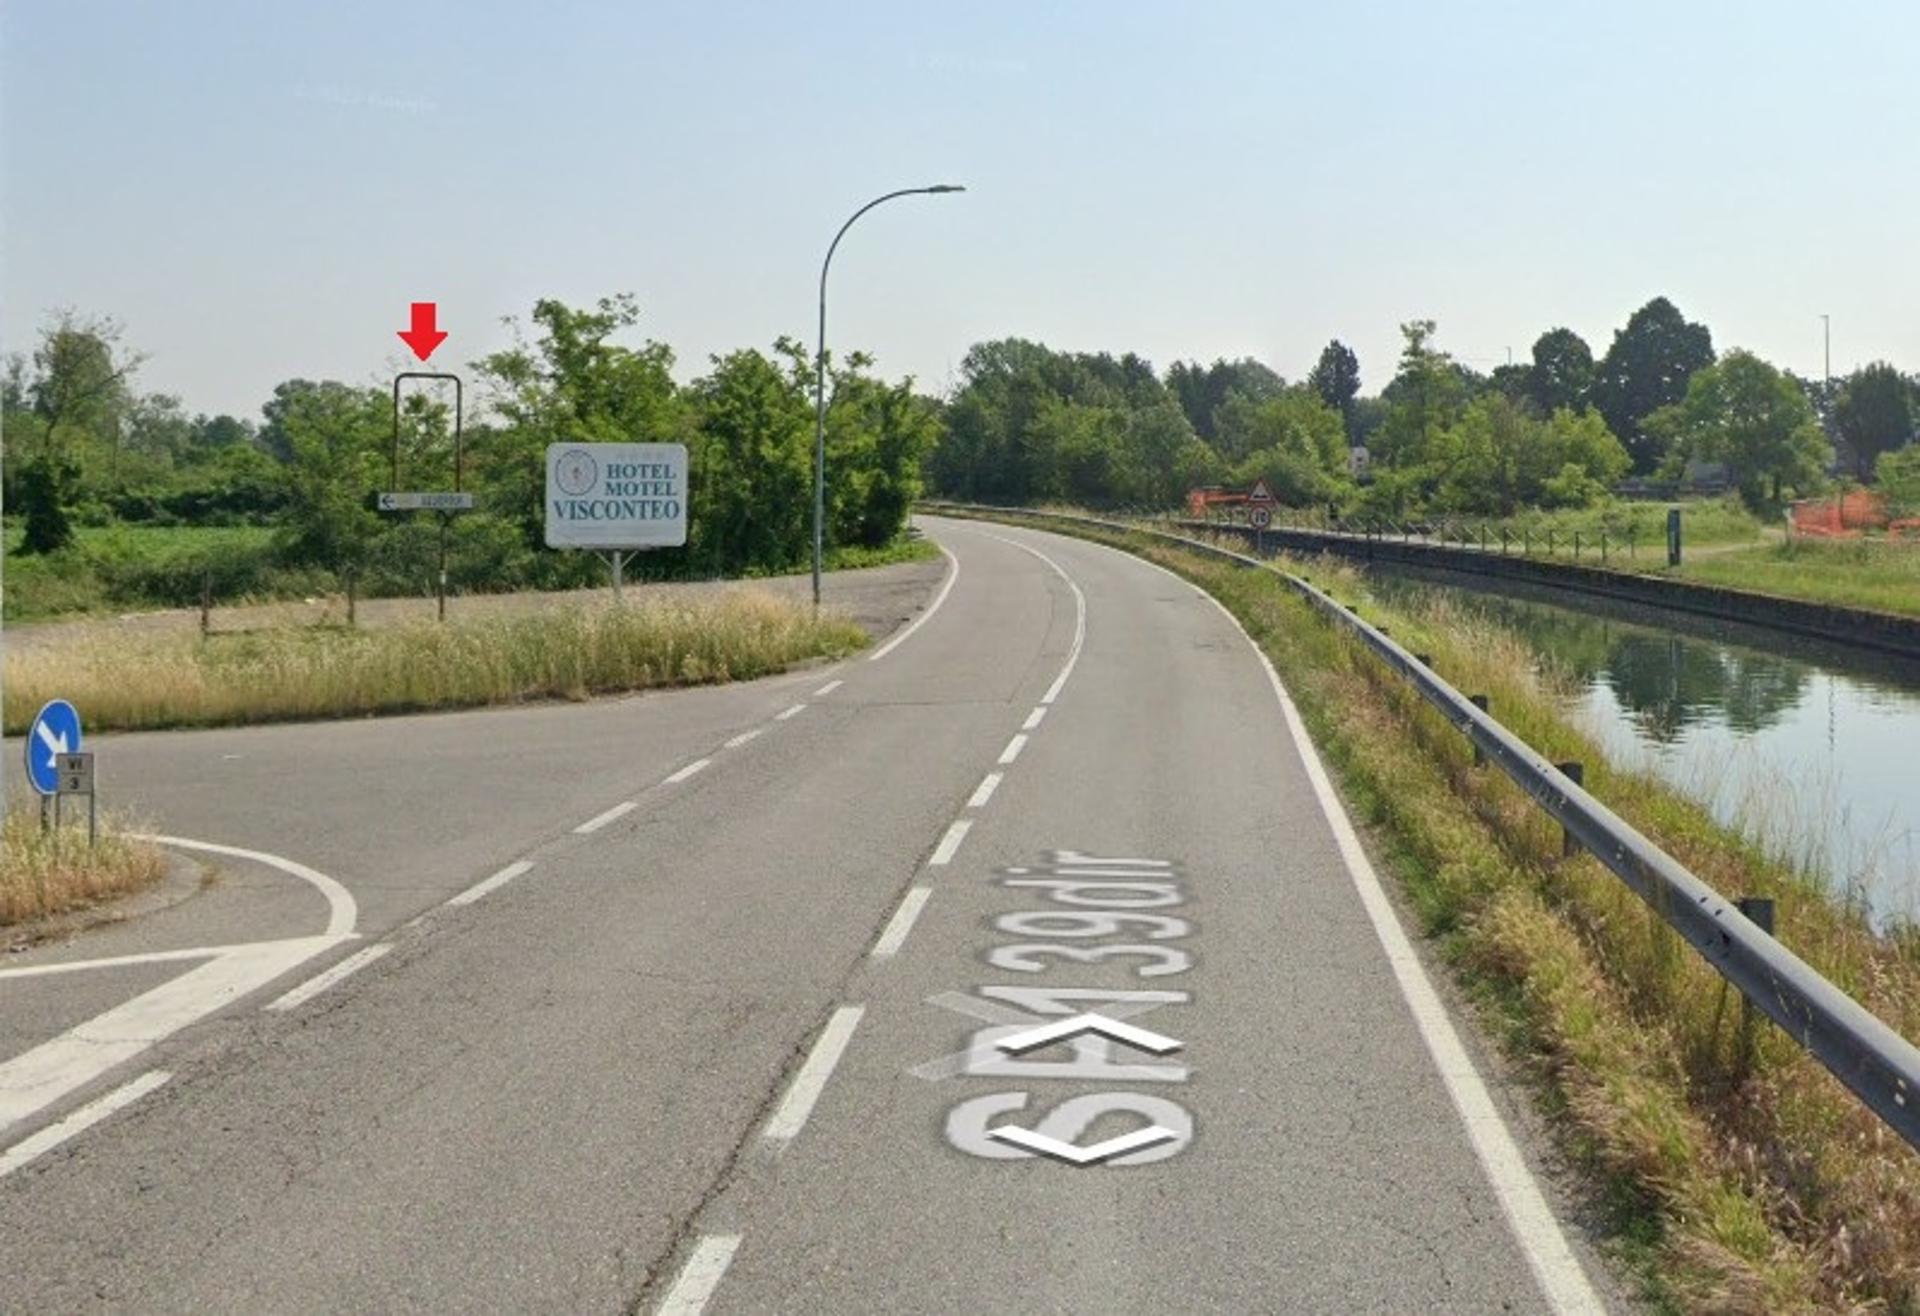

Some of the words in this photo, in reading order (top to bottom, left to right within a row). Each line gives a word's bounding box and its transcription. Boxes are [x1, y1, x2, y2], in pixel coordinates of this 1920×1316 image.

[606, 463, 677, 479] HOTEL
[605, 481, 677, 496] MOTEL
[553, 500, 680, 520] VISCONTEO
